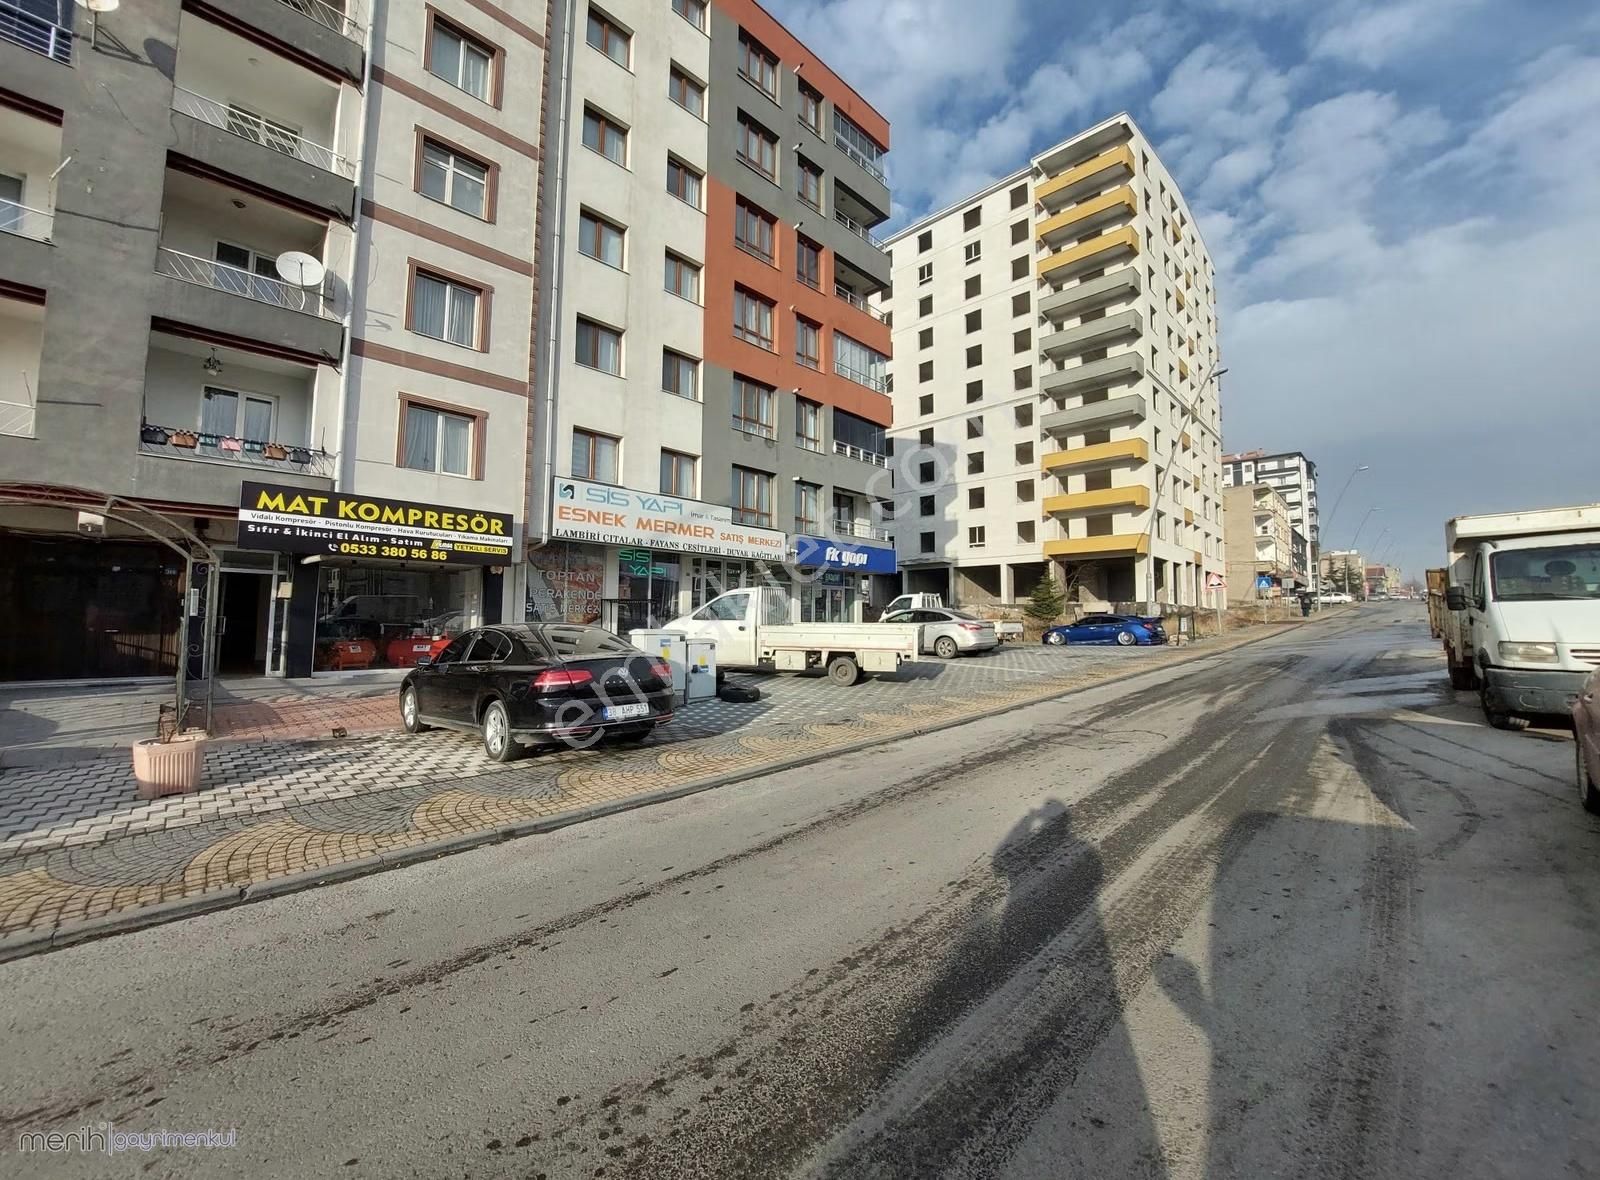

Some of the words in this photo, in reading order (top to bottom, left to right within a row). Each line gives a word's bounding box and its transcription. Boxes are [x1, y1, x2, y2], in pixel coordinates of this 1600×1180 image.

[256, 490, 328, 515] MAT
[338, 500, 504, 534] KOMPRESÖR
[636, 494, 683, 515] YAPI
[251, 512, 274, 521] Vidalı
[276, 516, 316, 525] Kompresör
[324, 520, 354, 528] Pistonlu
[356, 523, 392, 533] Kompresör
[558, 506, 627, 528] ESNEK
[636, 516, 715, 539] MERMER
[720, 533, 744, 544] SATIŞ
[748, 535, 782, 548] MERKEZİ
[247, 524, 280, 534] Sıfır
[336, 532, 348, 540] El
[352, 534, 380, 543] Alım
[390, 538, 423, 547] Satım
[556, 528, 600, 541] LAMBİRİ
[603, 534, 643, 546] ÇITALAR
[650, 540, 680, 550] FAYANS
[682, 543, 721, 554] ÇEŞİTLERİ
[340, 542, 377, 555] 0533
[381, 546, 407, 558] 380
[411, 549, 428, 560] 56
[430, 550, 448, 561] 86
[537, 569, 595, 582] TOPTAN
[629, 564, 667, 578] YAPI
[529, 588, 602, 600] PERAKENDE
